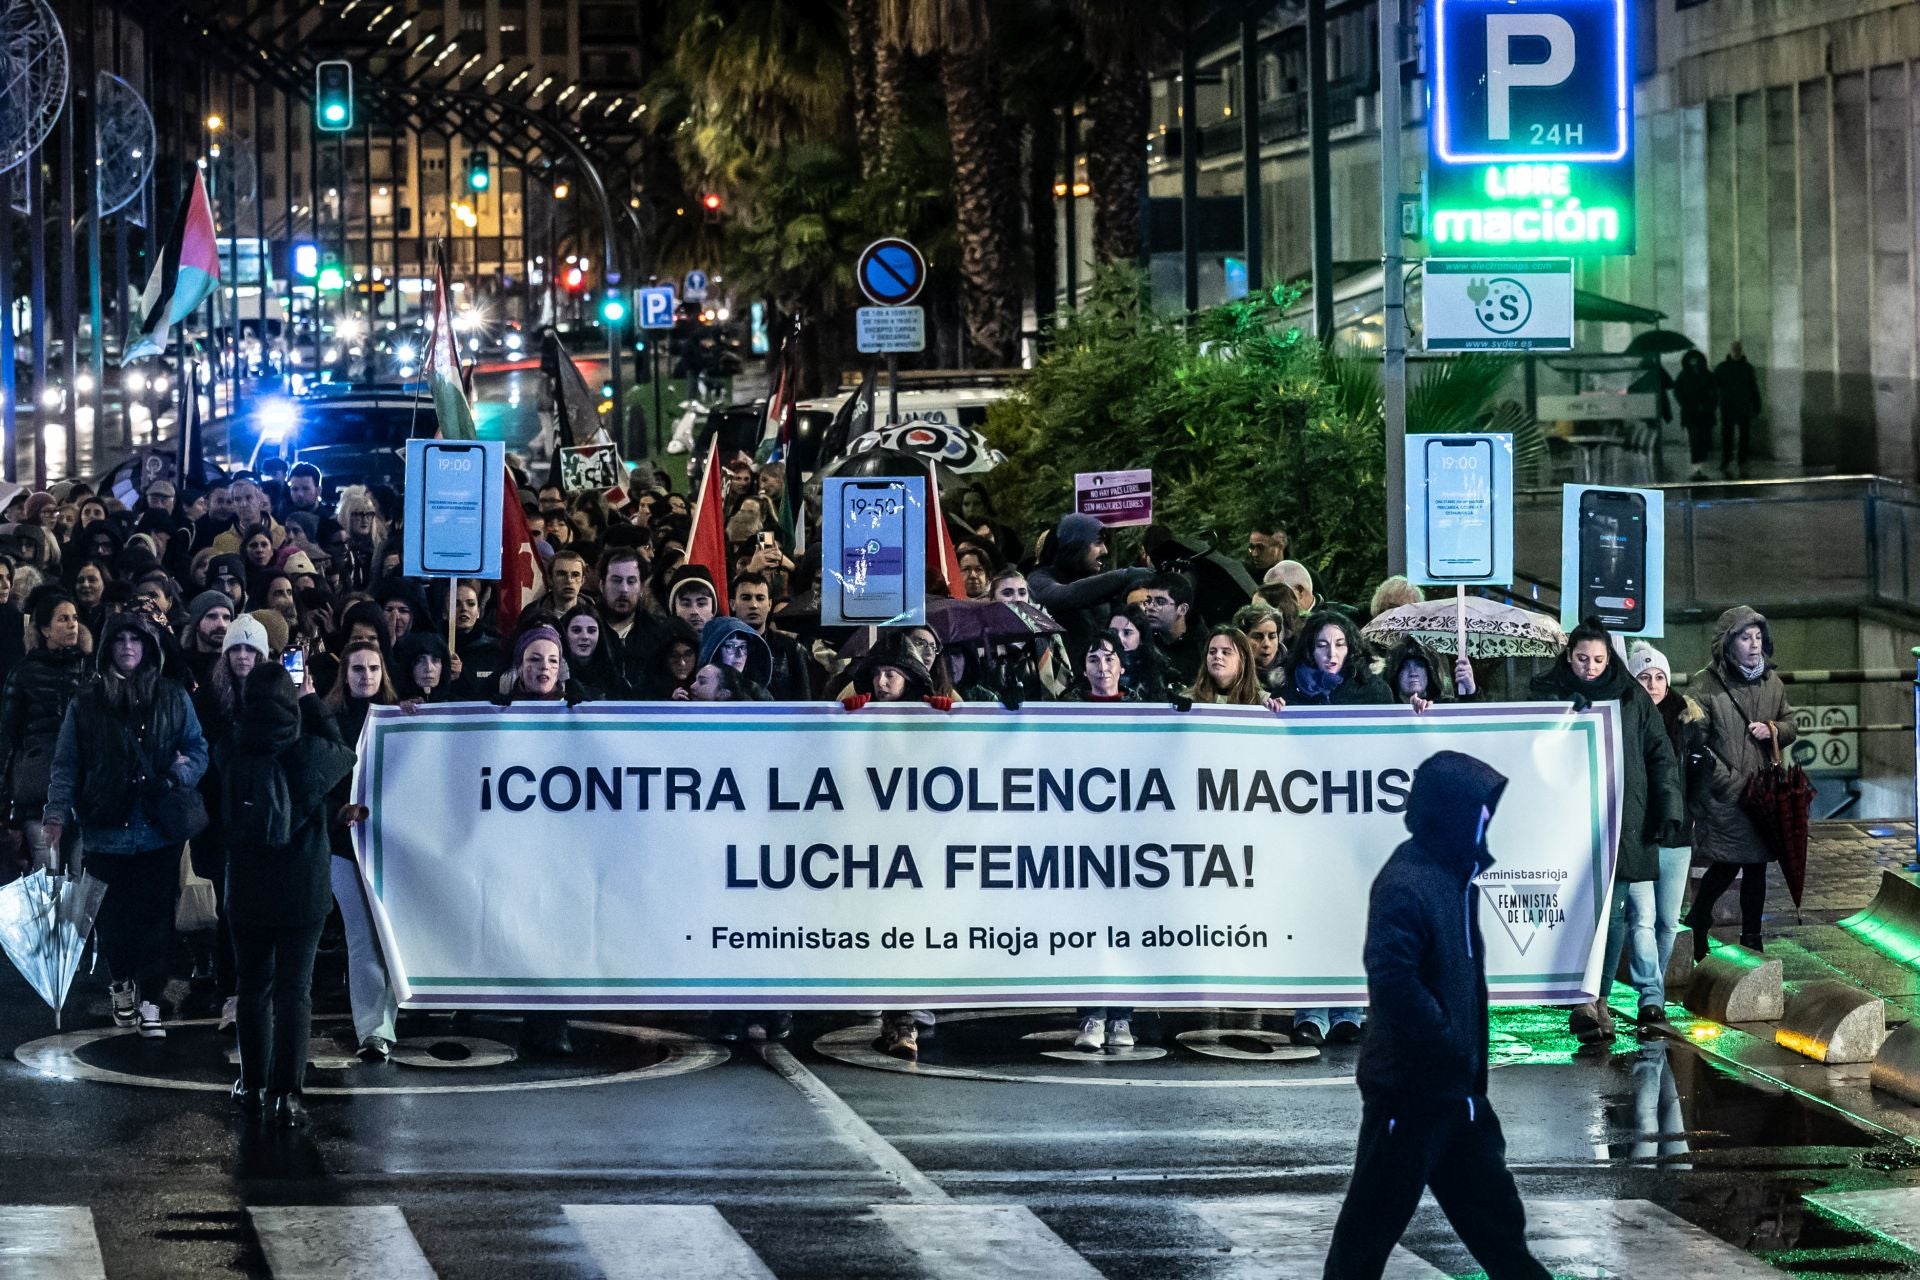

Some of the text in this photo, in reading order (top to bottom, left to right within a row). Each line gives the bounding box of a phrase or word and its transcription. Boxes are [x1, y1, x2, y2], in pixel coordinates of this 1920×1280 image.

[1486, 13, 1576, 141] P
[1530, 123, 1584, 145] 24H
[1485, 165, 1570, 197] LIBRE
[1433, 199, 1619, 242] mación
[646, 293, 668, 325] P
[1465, 339, 1533, 349] www.syder.es
[438, 458, 472, 472] 19:00
[1442, 456, 1478, 470] 19:00
[850, 498, 897, 516] 19:50
[480, 765, 1418, 814] ¡CONTRA LA VIOLENCIA MACHIS
[725, 843, 1255, 890] LUCHA FEMINISTA!
[1498, 893, 1558, 909] FEMINISTAS
[1508, 908, 1565, 926] DE LA RIOJA
[711, 924, 1268, 956] Feministas de La Rioja por la abolición
